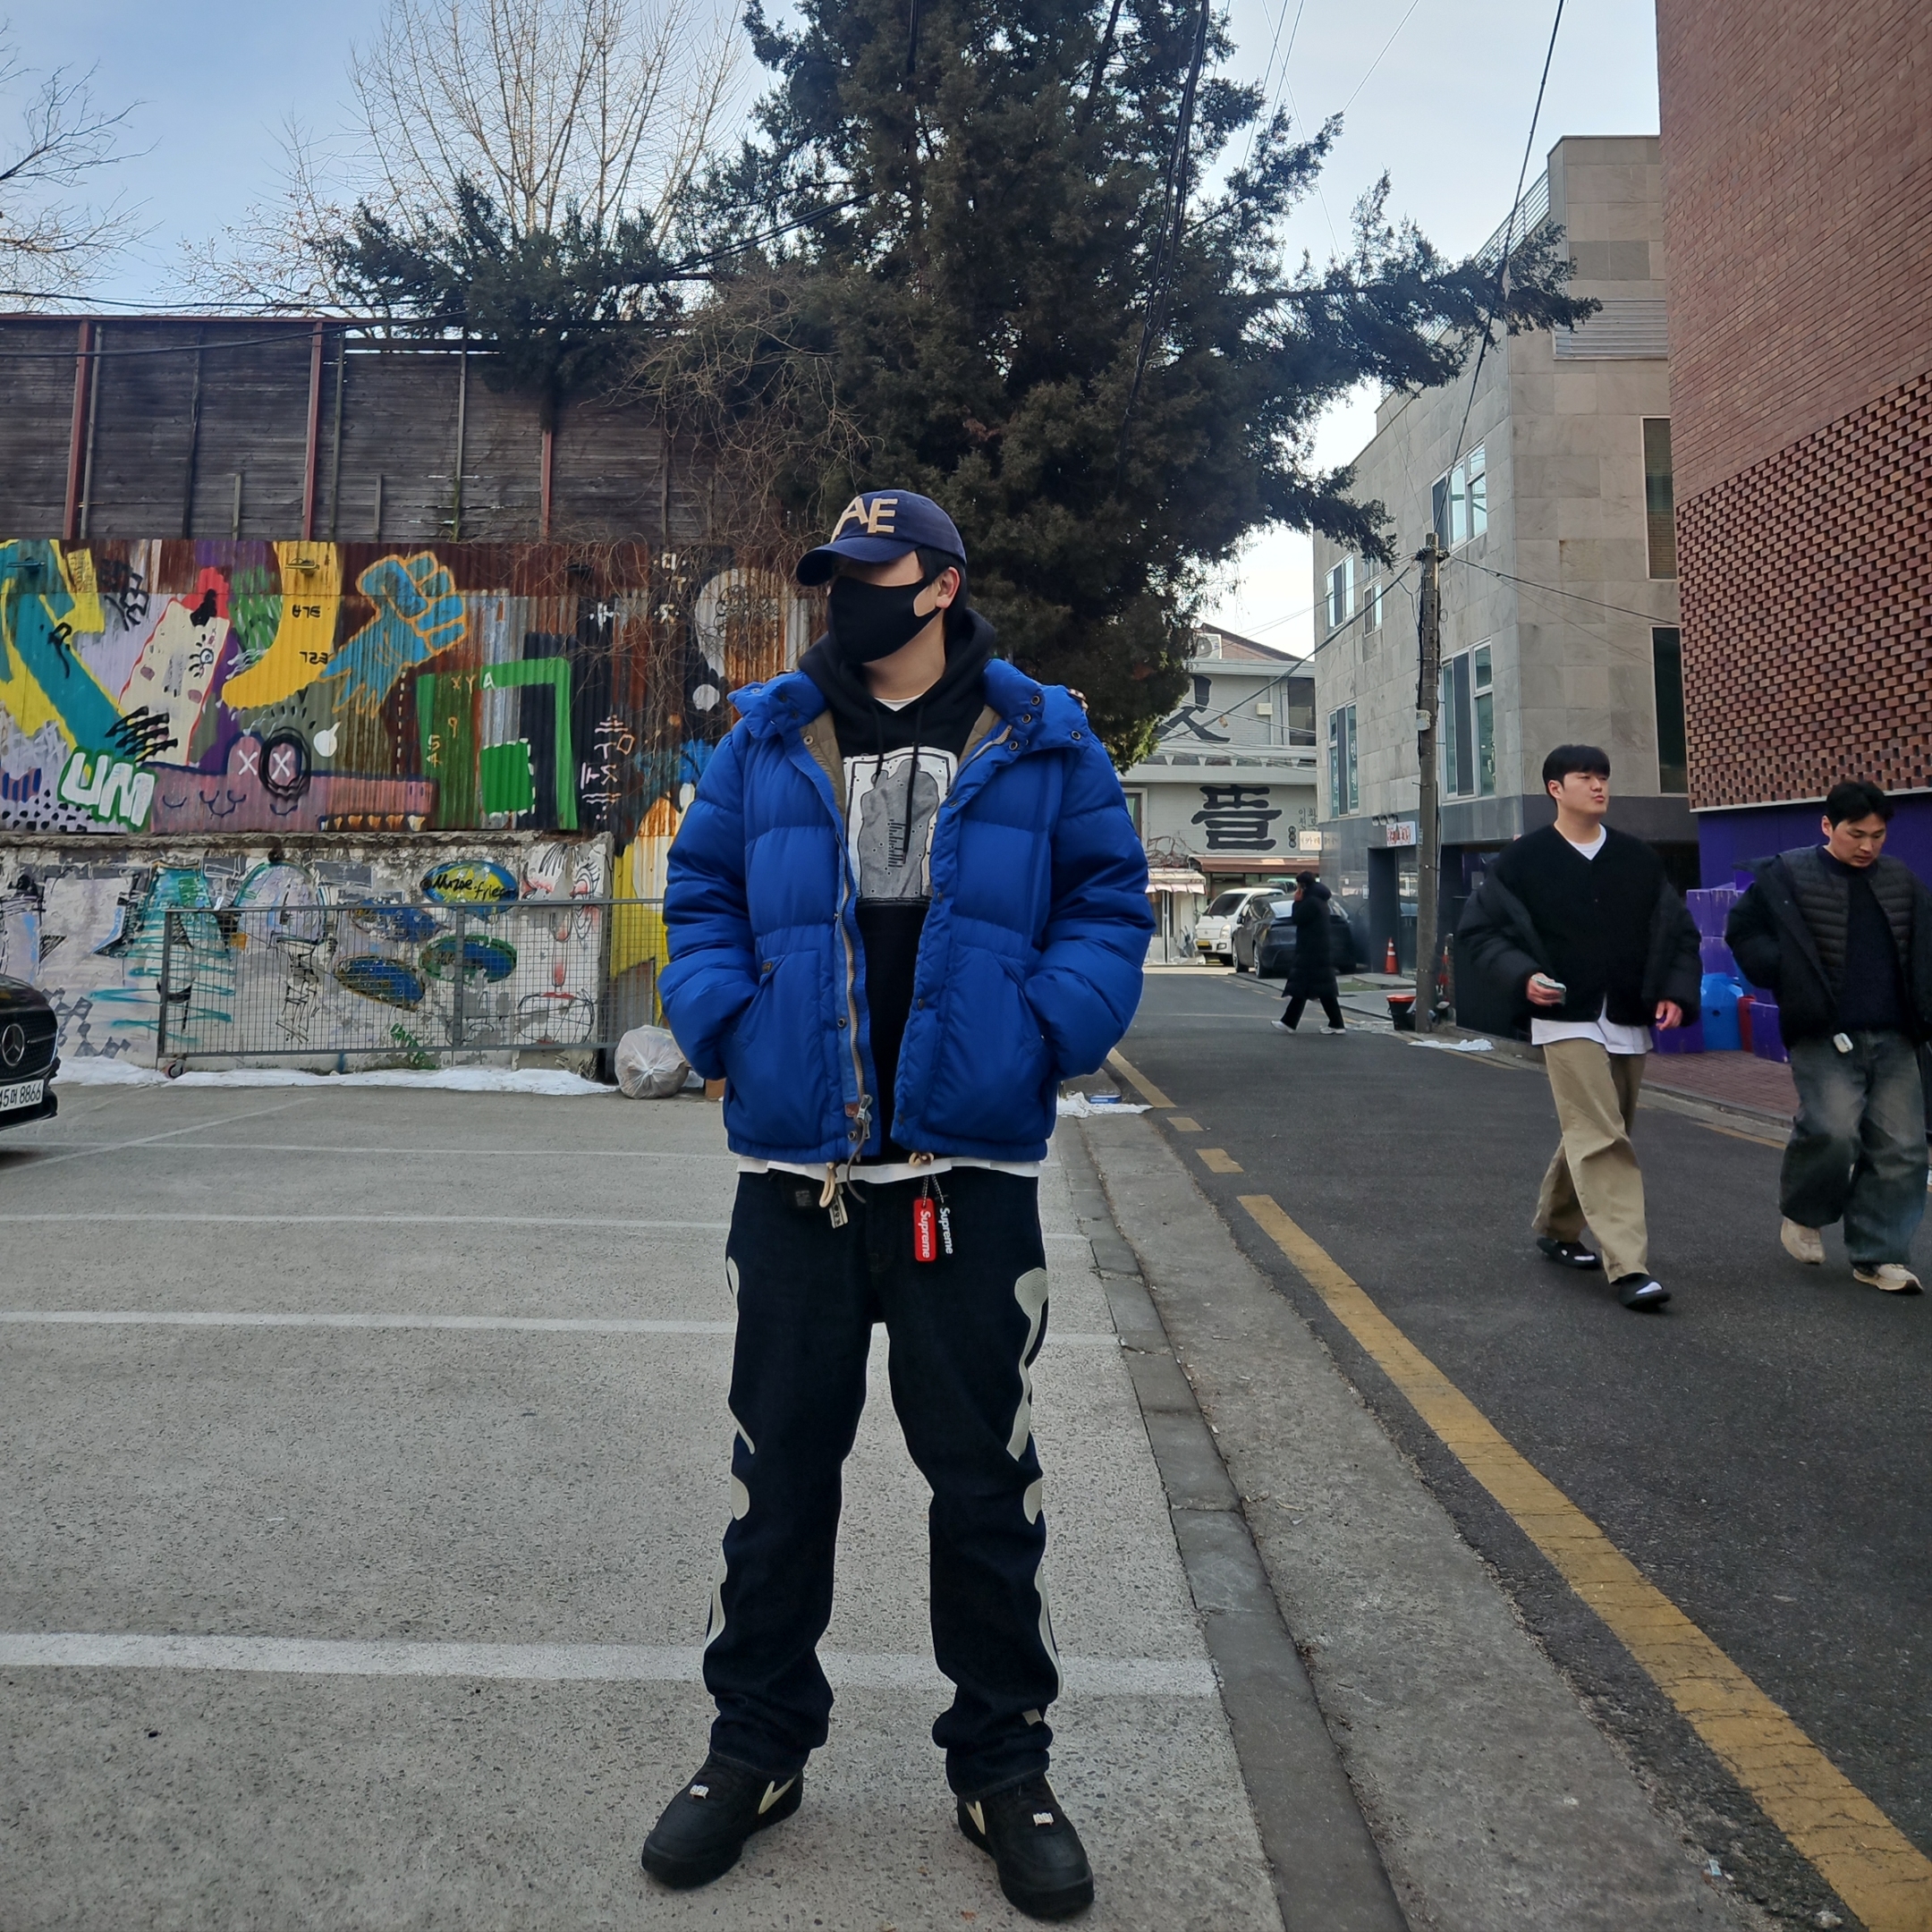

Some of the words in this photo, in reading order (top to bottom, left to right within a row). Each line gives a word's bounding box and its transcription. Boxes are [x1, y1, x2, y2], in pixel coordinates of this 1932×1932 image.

[830, 496, 898, 544] AE
[20, 1082, 41, 1104] 8866
[918, 1210, 931, 1258] Supreme
[938, 1207, 953, 1254] Supreme
